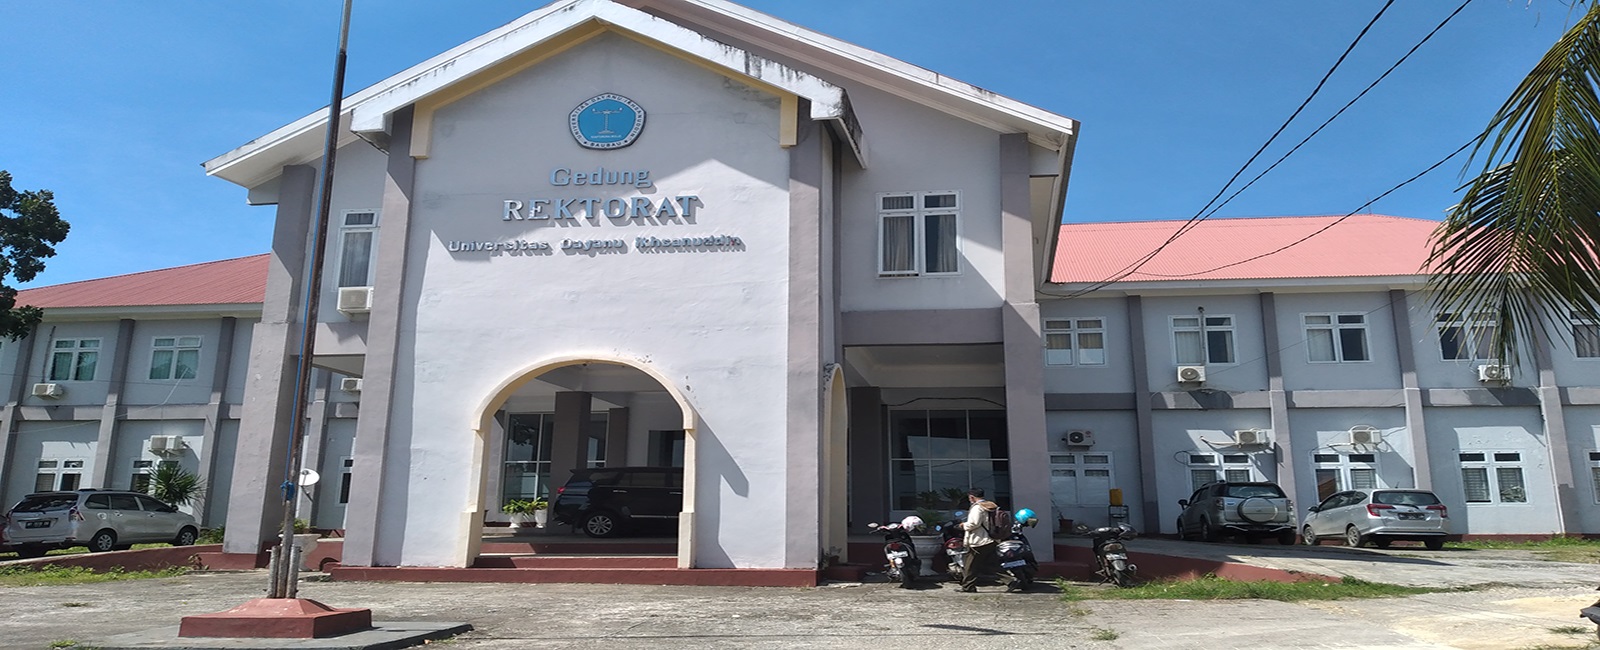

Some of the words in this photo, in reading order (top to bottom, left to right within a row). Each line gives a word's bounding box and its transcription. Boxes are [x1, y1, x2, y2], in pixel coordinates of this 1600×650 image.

[571, 101, 590, 140] UNIVERSITAS
[591, 94, 622, 103] DAYANU
[623, 98, 643, 138] IKHSANUDDIN
[549, 166, 653, 188] Gedung
[502, 195, 699, 221] REKTORAT
[448, 239, 549, 252] Universitas
[560, 238, 623, 251] Dayanu
